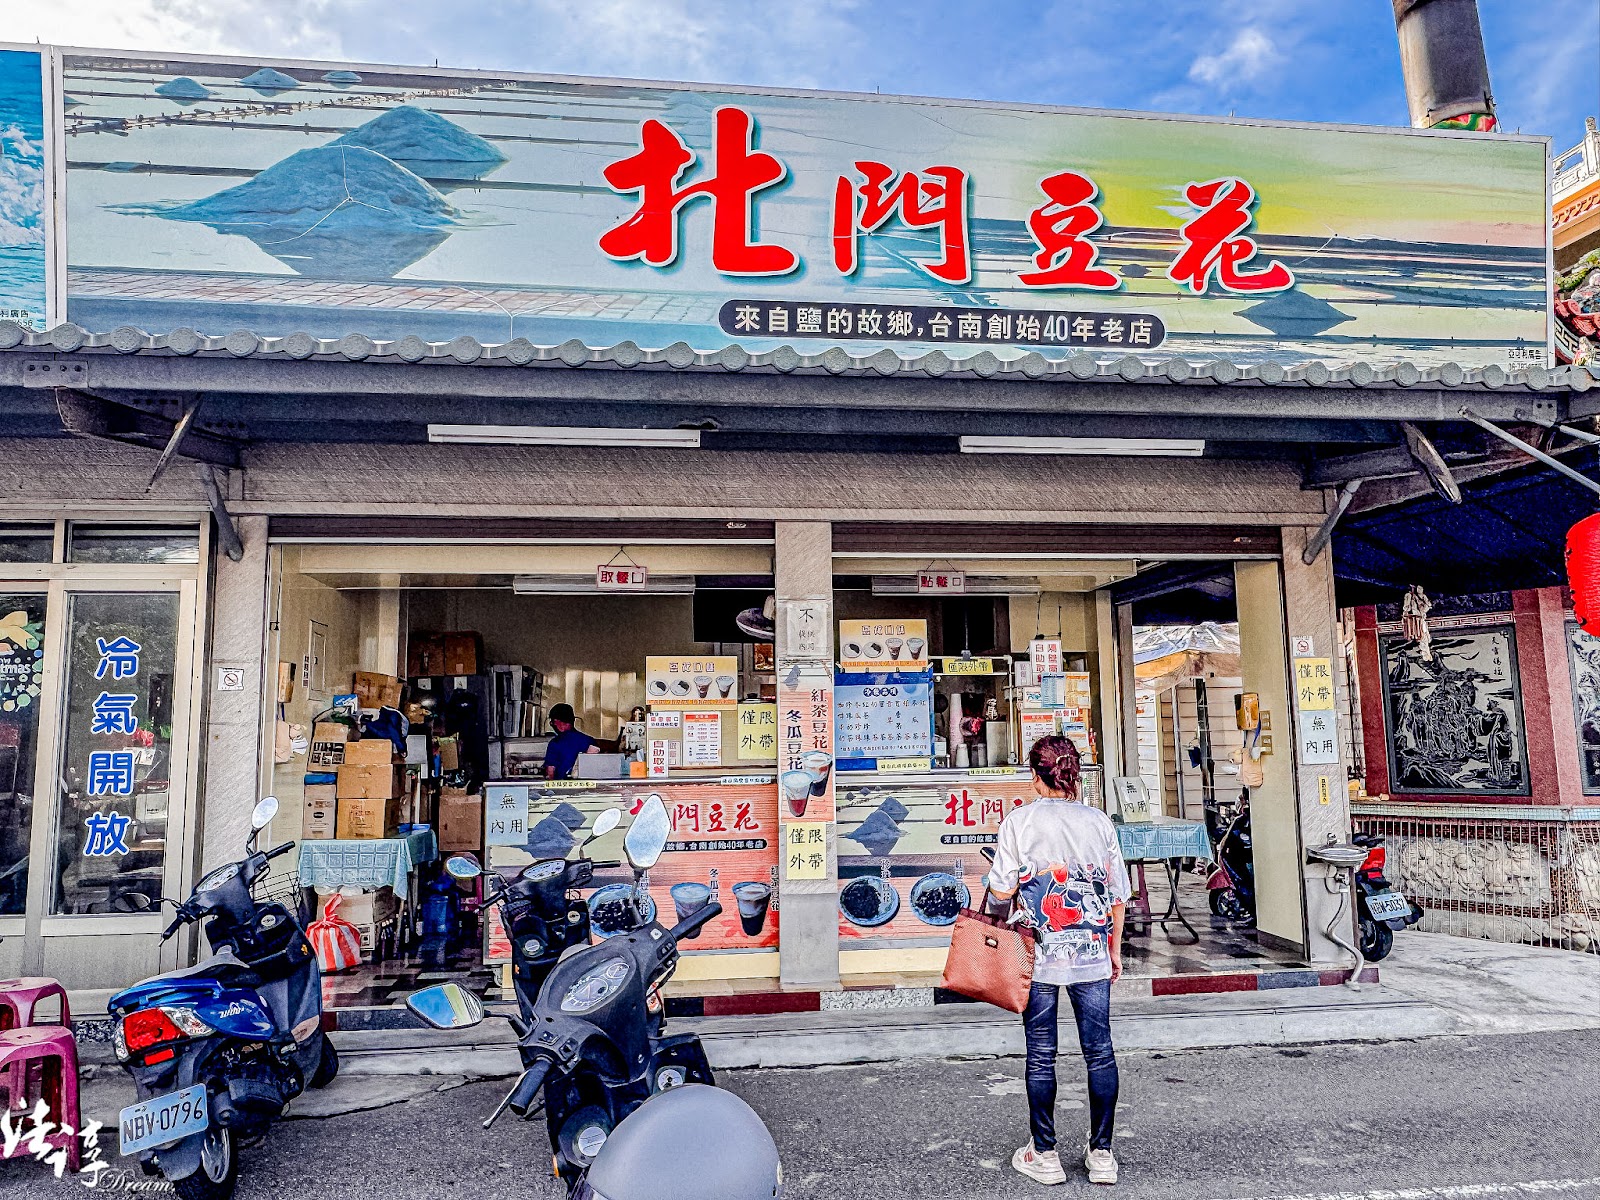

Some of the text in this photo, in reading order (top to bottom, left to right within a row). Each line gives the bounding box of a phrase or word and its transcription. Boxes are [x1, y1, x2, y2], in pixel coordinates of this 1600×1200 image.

[599, 106, 1295, 292] 北門豆花
[1298, 664, 1330, 678] 僅限
[1301, 686, 1331, 702] 外帶
[741, 709, 774, 725] 僅限
[811, 688, 829, 749] 紅茶豆花
[1312, 715, 1326, 730] 無
[83, 636, 141, 856] 冷氣開放
[741, 733, 774, 751] 外帶
[786, 709, 803, 770] 冬瓜豆花
[1306, 739, 1333, 754] 內用
[500, 793, 516, 809] 無
[945, 790, 1023, 827] 北門
[629, 798, 759, 833] 門豆花
[490, 819, 524, 834] 內用
[789, 828, 824, 844] 僅限
[790, 853, 824, 871] 外帶
[123, 1096, 203, 1145] NBV-0796
